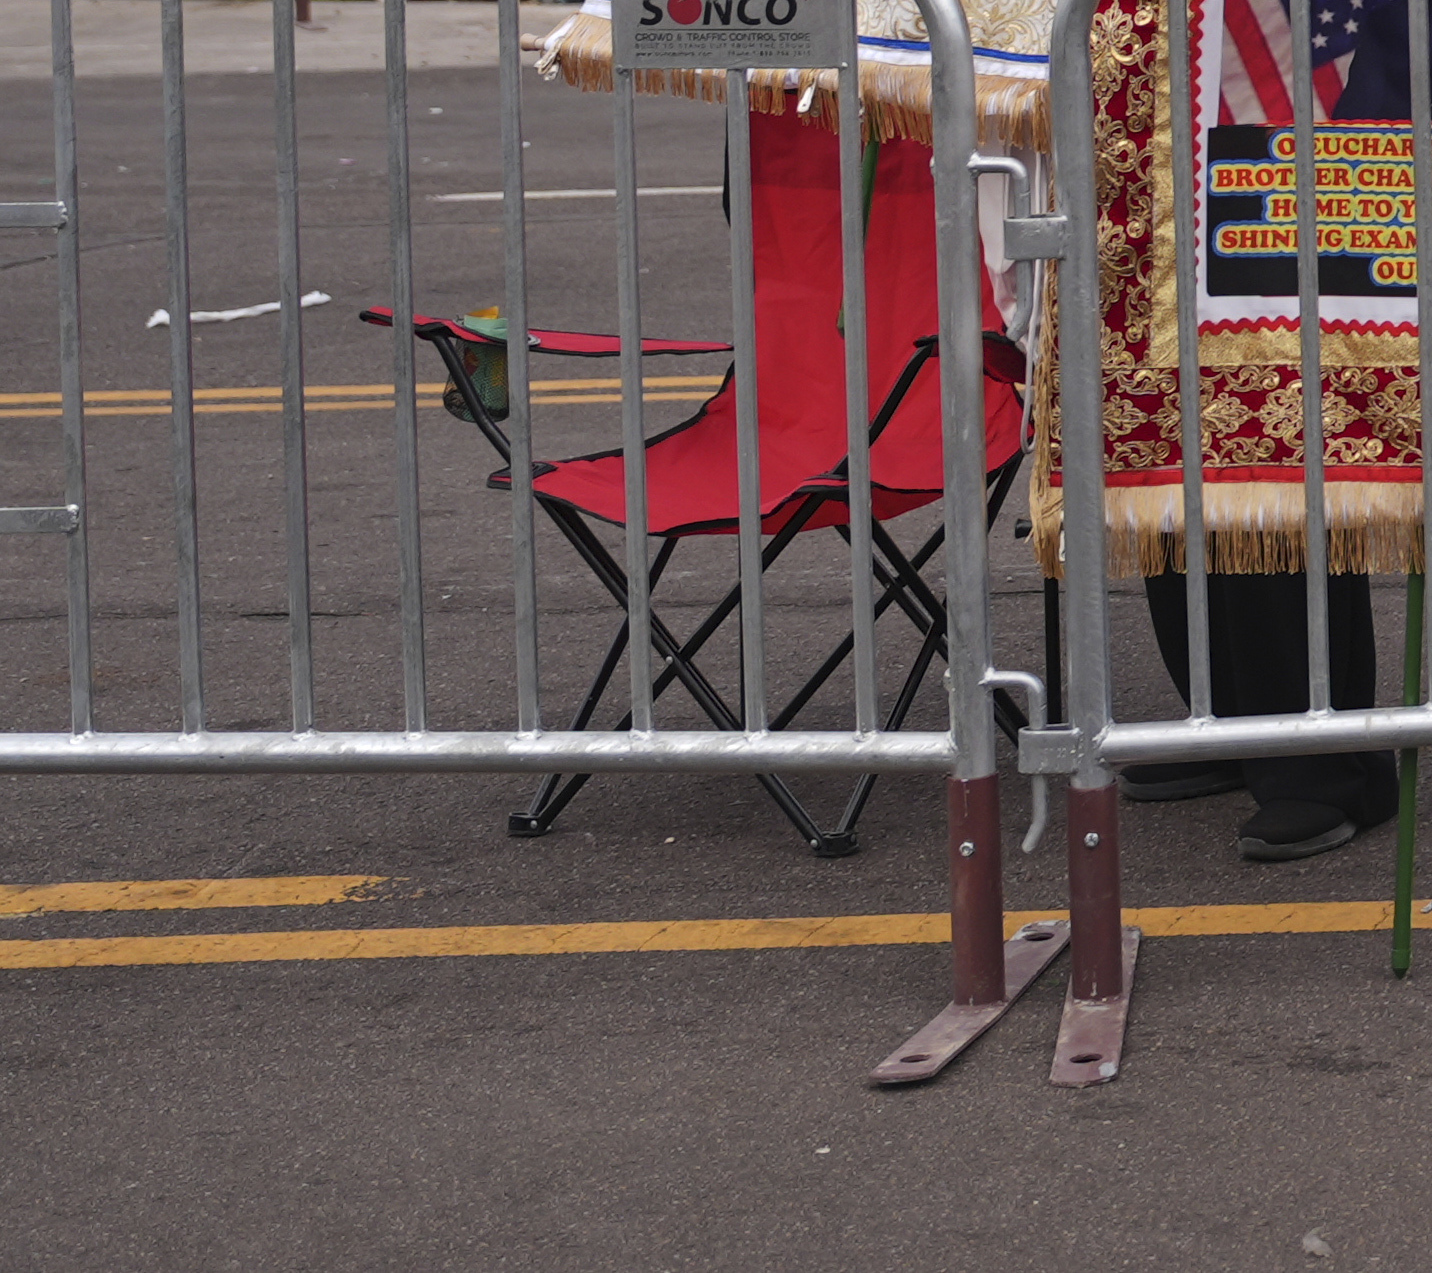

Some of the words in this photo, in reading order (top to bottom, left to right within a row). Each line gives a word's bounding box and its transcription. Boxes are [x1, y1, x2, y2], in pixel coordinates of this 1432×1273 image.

[635, 32, 672, 42] CROWD
[687, 32, 727, 42] TRAFFIC
[729, 32, 776, 42] CONTROL
[779, 32, 811, 42] STORE
[1278, 137, 1296, 156] O
[1216, 167, 1350, 188] BROTER
[1271, 198, 1351, 217] HME
[1358, 198, 1393, 218] TO
[1377, 260, 1415, 281] OU
